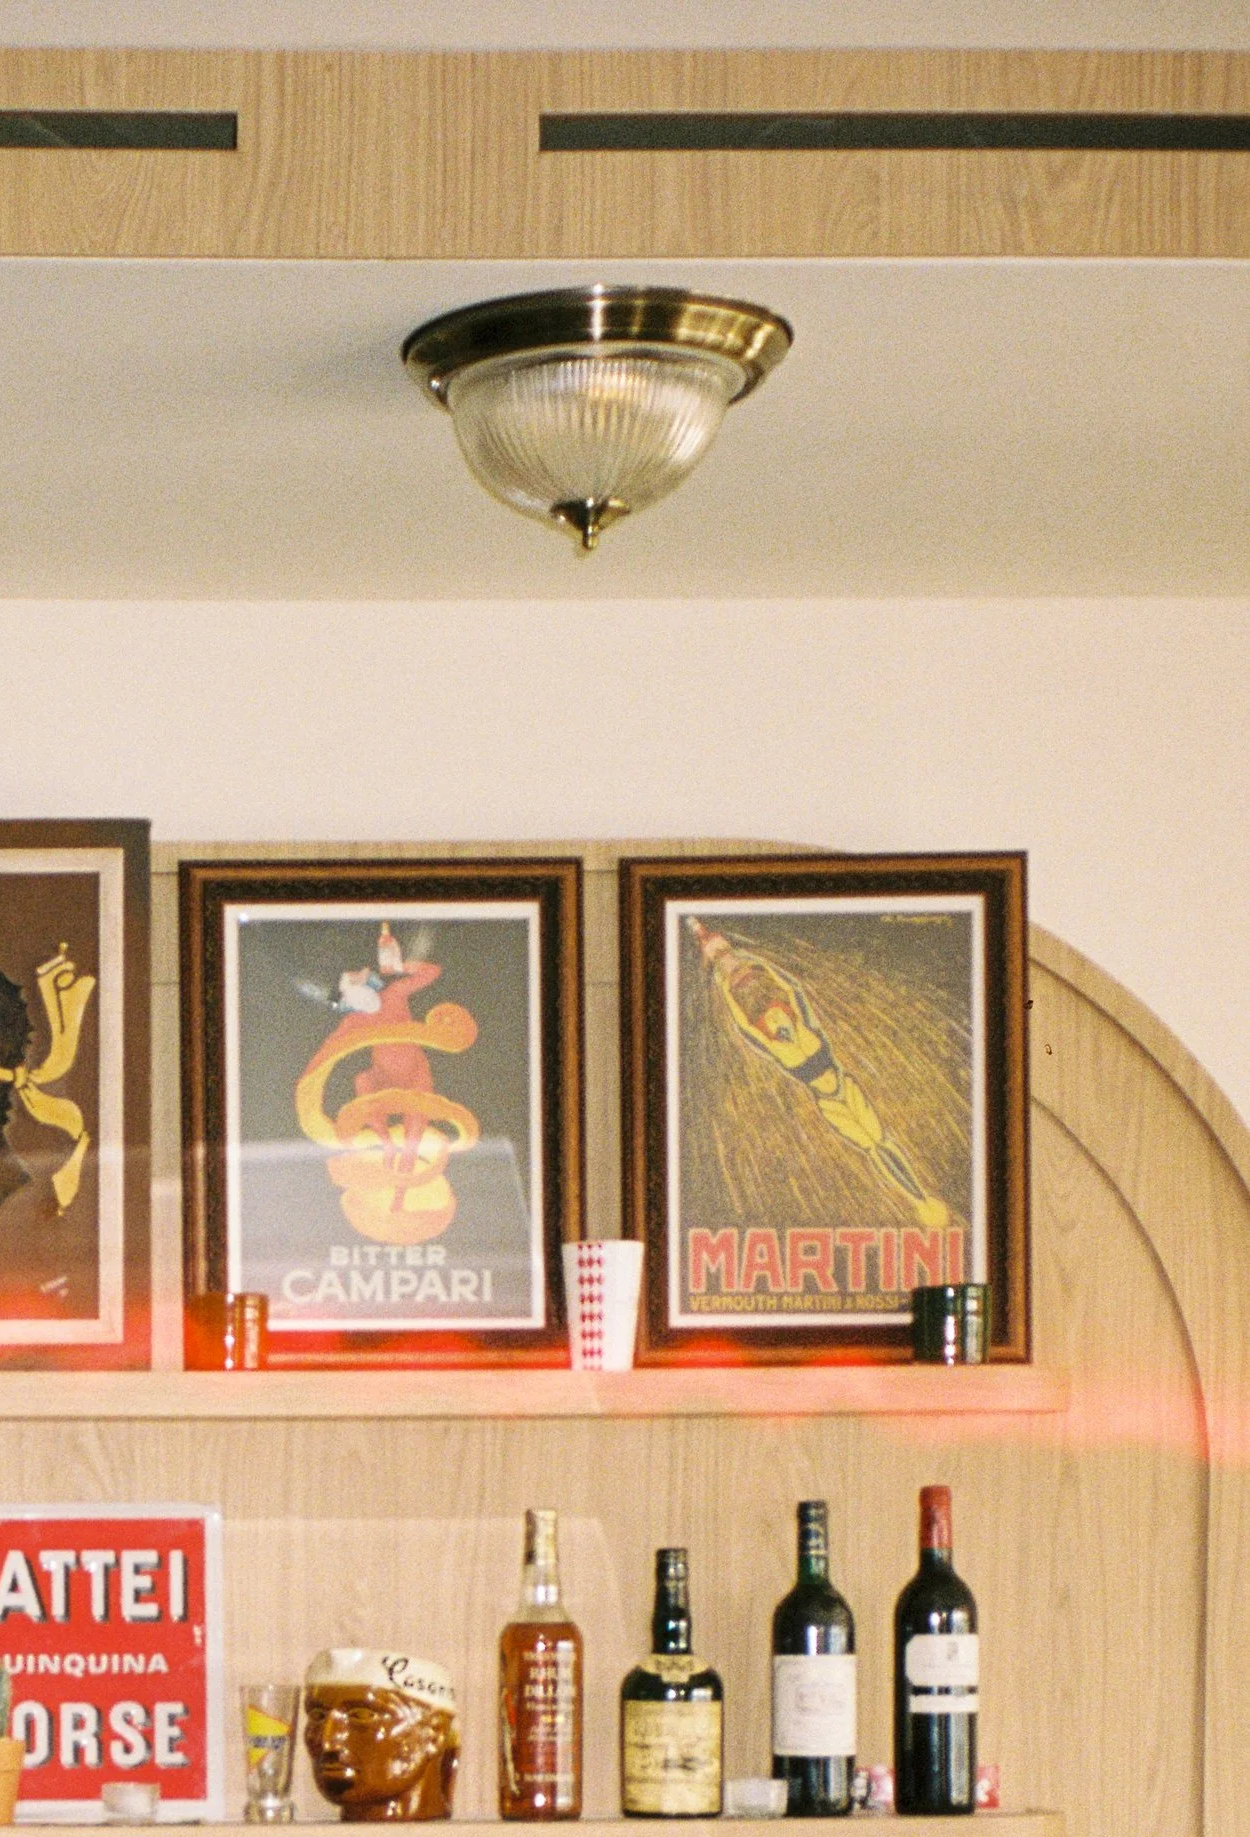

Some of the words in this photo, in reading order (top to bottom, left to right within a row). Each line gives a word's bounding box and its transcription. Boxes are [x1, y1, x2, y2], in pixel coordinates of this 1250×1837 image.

[329, 1243, 448, 1267] BITTER
[688, 1226, 965, 1293] MARTINI
[281, 1268, 494, 1303] CAMPARI
[689, 1294, 777, 1311] VERMOUTH
[781, 1294, 843, 1311] MARTINI
